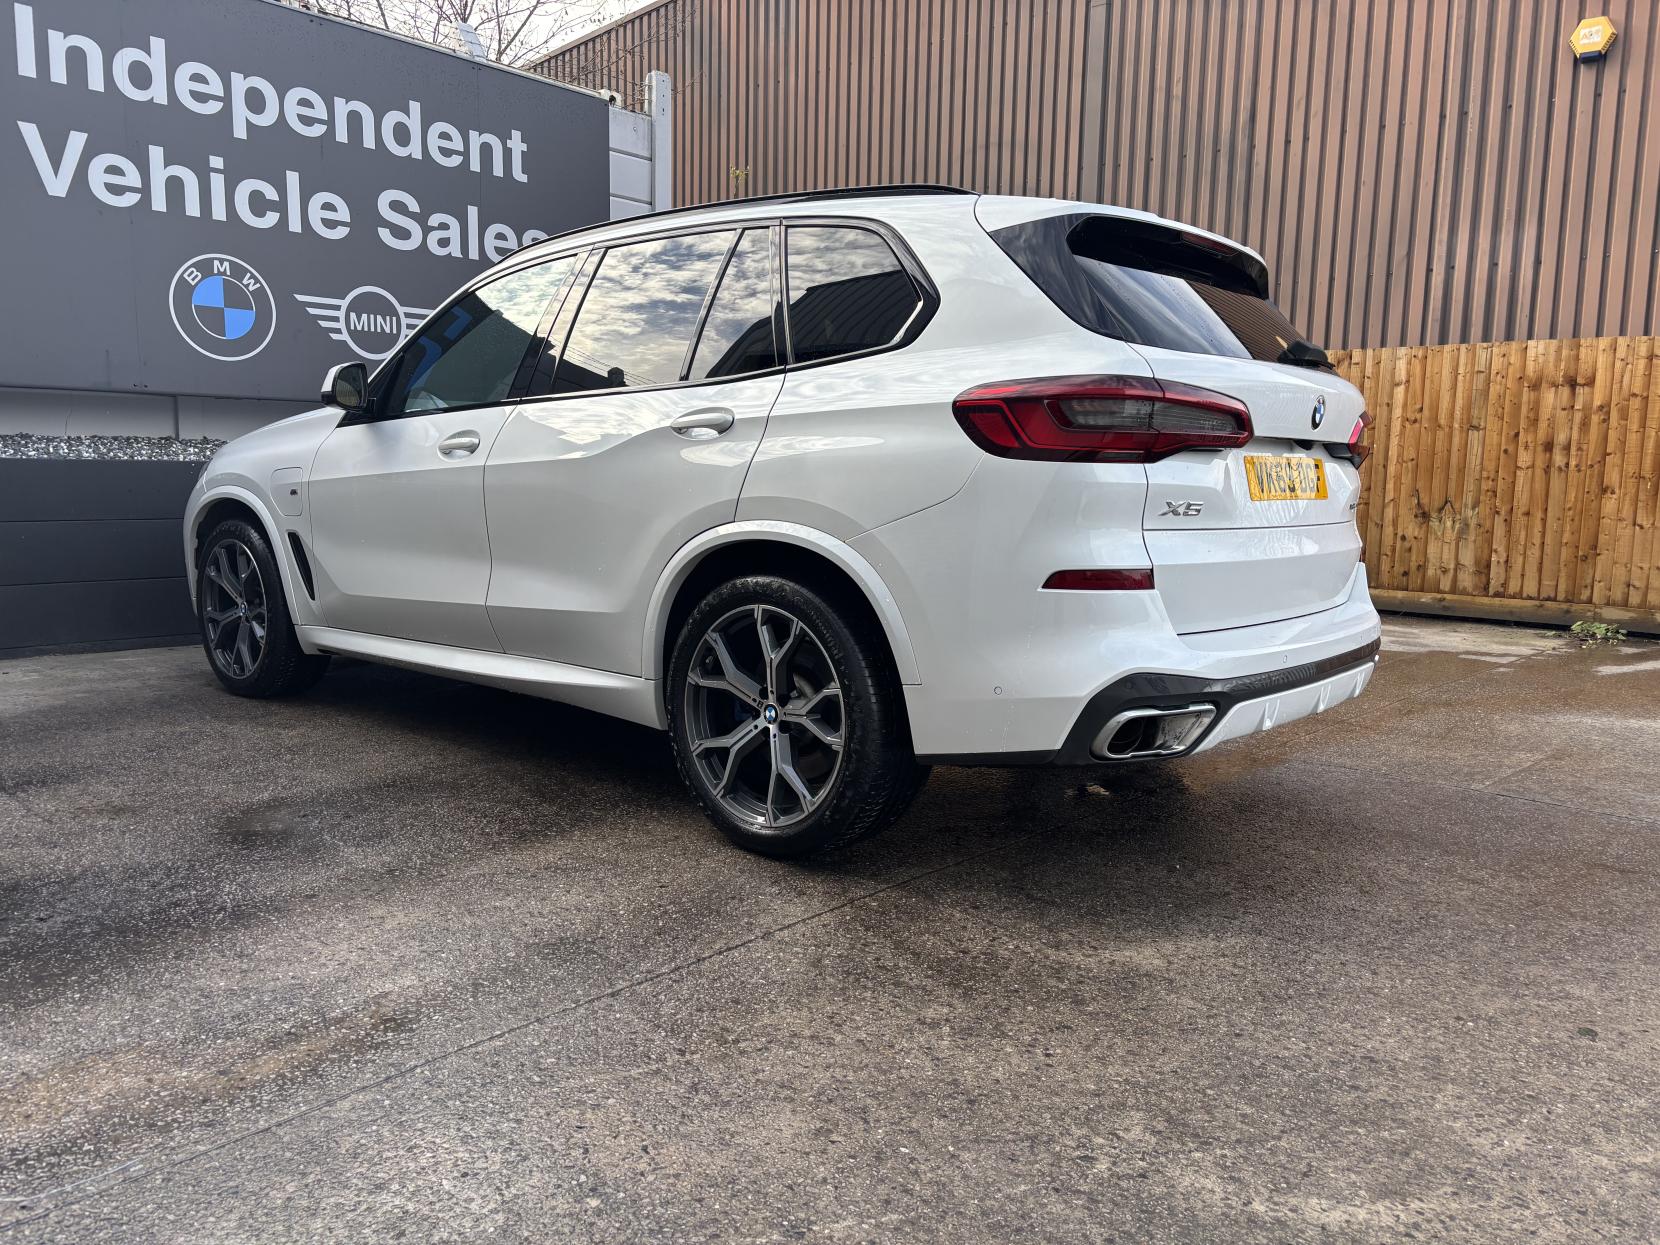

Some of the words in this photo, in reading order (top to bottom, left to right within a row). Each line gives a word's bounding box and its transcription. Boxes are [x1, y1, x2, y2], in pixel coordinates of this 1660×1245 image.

[14, 3, 528, 183] Independent
[17, 121, 351, 240] Vehicle
[183, 260, 260, 292] BMW
[350, 312, 397, 334] MINI
[1158, 500, 1204, 516] X5
